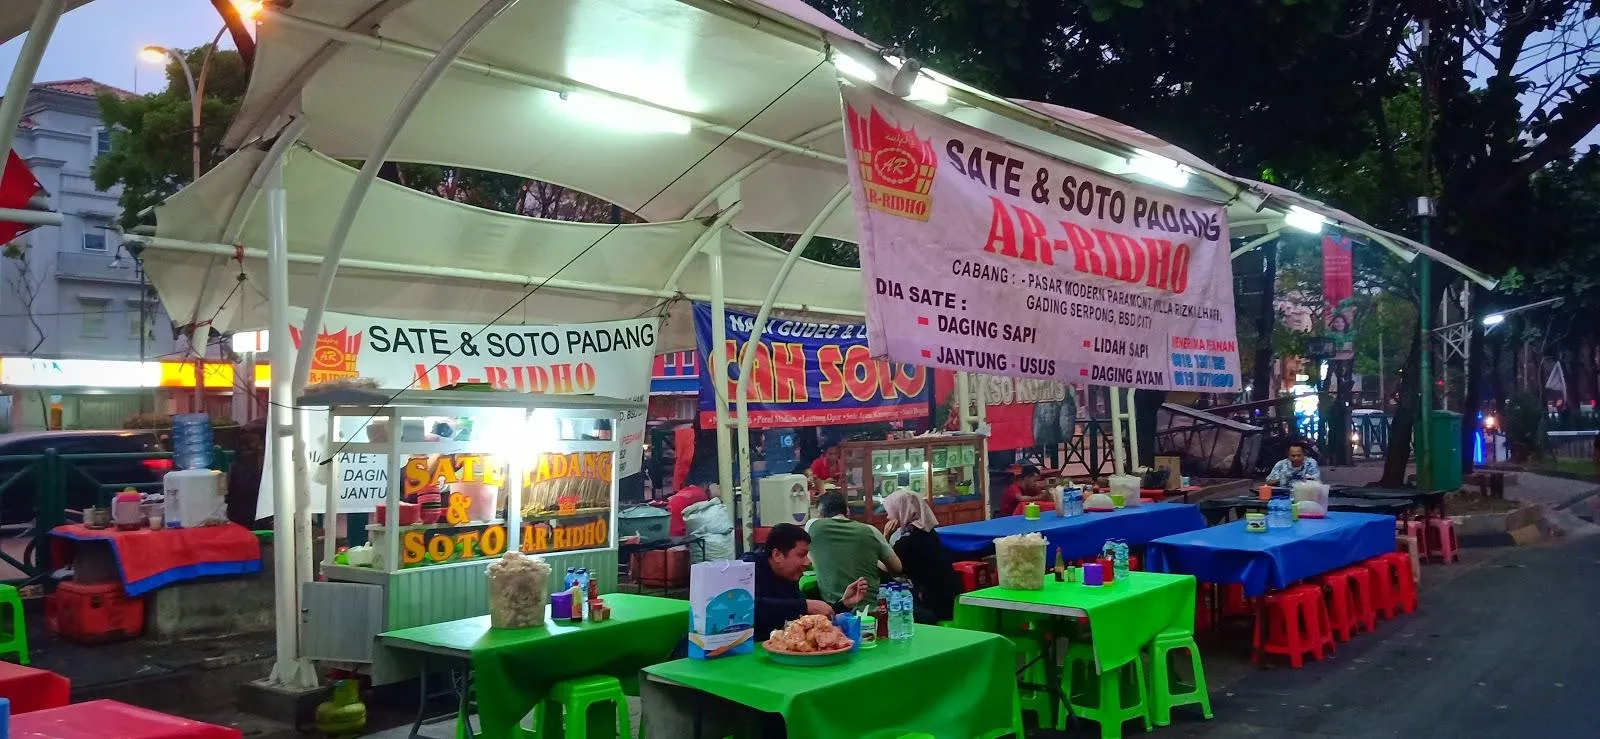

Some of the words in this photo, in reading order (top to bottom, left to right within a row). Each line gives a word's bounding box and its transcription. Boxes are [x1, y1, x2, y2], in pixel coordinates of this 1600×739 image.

[868, 188, 927, 216] R-RIDHO
[945, 138, 1024, 197] SATE
[1031, 167, 1050, 206] &
[1058, 175, 1126, 224] SOTO
[1133, 195, 1221, 242] PADANG
[983, 195, 1190, 294] AR-RIDHO
[952, 259, 1009, 284] CABANG
[1028, 273, 1062, 295] PASAR
[1064, 281, 1105, 301] MODERN
[909, 286, 957, 310] SATE
[1026, 295, 1068, 316] GADING
[1070, 302, 1117, 326] SERPONG,
[1119, 311, 1136, 326] BSD
[369, 325, 450, 354] SATE
[460, 331, 480, 357] &
[486, 331, 560, 357] SOTO
[567, 323, 654, 355] PADANG
[778, 321, 840, 339] GUDEG
[840, 324, 857, 339] &
[938, 315, 998, 339] DAGING
[1002, 324, 1037, 344] SAPI
[936, 346, 1007, 371] JANTUNG
[1020, 356, 1056, 376] USUS
[1094, 337, 1126, 356] LIDAH
[1128, 342, 1149, 358] SAPI
[954, 373, 1014, 406] AKSO
[1091, 364, 1133, 384] DAGING
[1135, 370, 1164, 385] AYAM
[343, 469, 388, 482] DAGIN
[404, 455, 504, 494] SATE
[340, 487, 388, 499] JANTU
[447, 491, 473, 525] &
[404, 524, 505, 564] SOTO
[522, 524, 548, 553] AR
[553, 518, 608, 550] RIDHO
